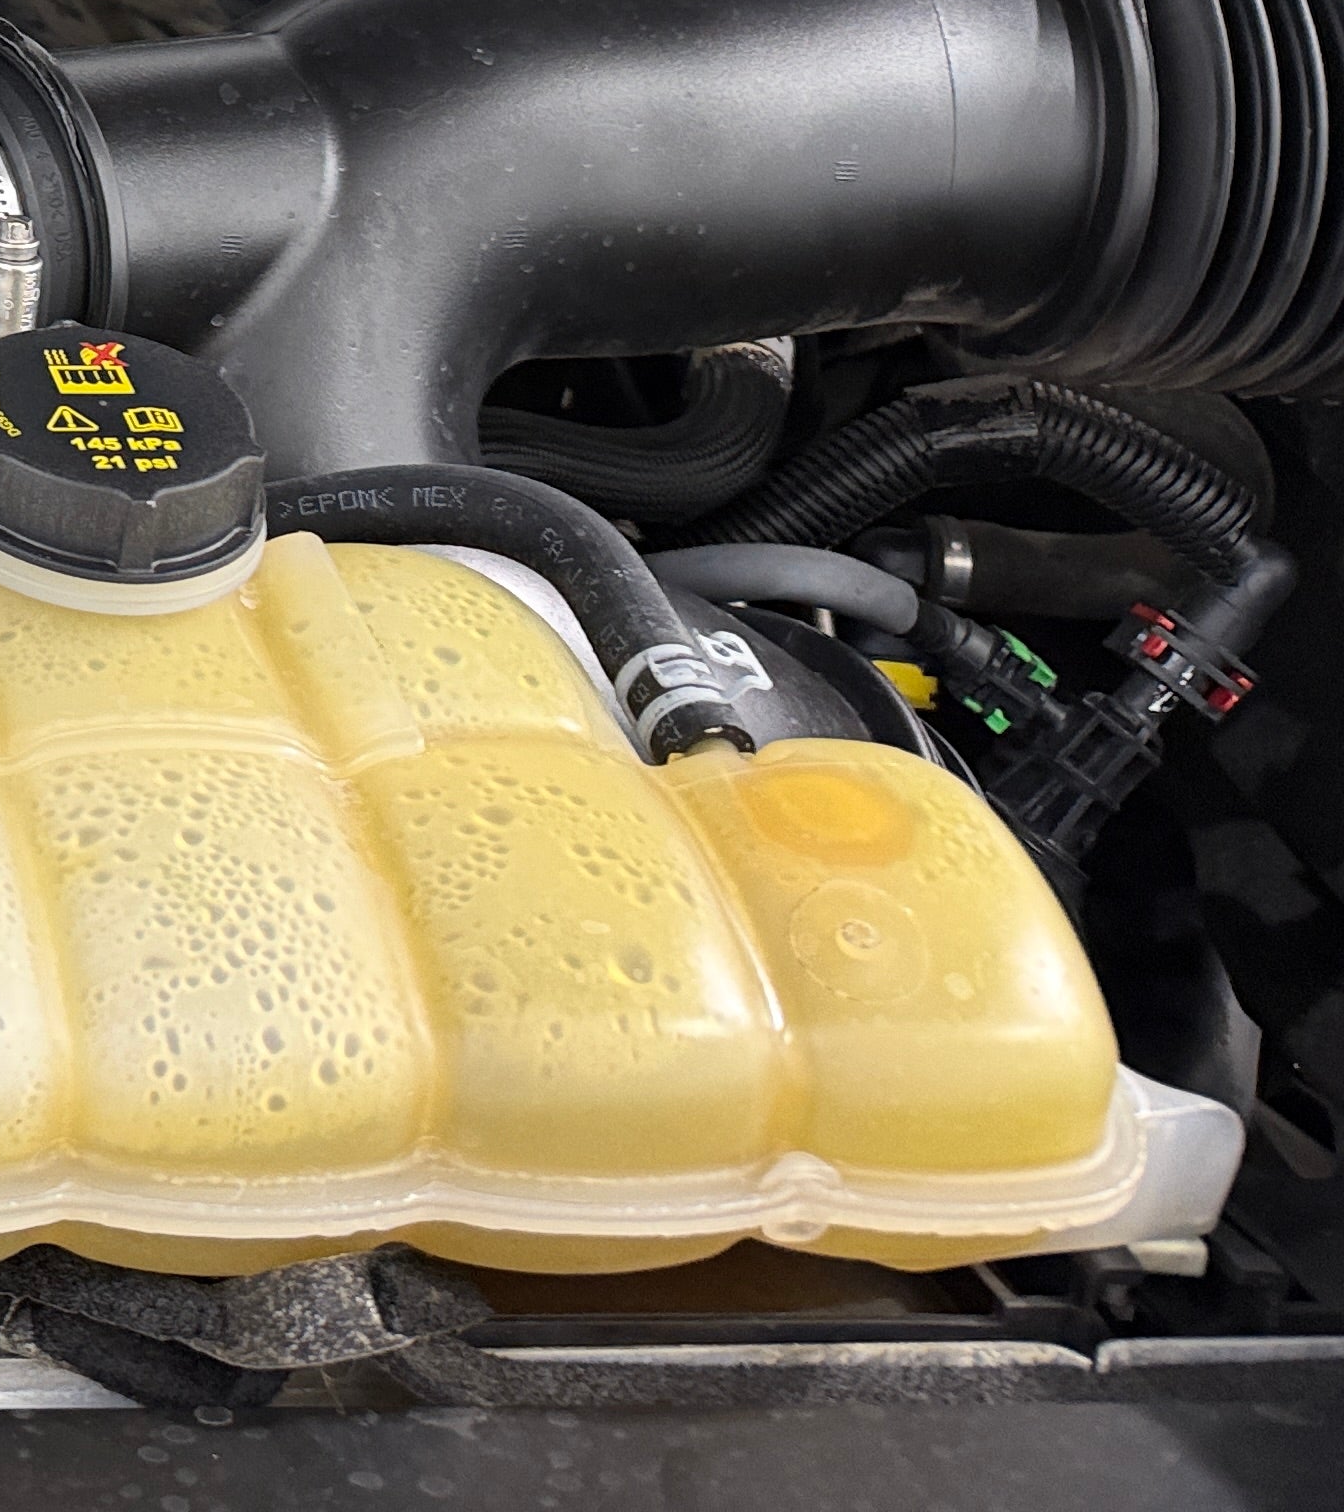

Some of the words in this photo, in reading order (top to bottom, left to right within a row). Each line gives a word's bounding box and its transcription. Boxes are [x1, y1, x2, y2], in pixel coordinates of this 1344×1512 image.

[70, 437, 122, 451] 145
[126, 437, 182, 451] kPa
[92, 455, 127, 470] 21
[134, 455, 178, 472] psi
[412, 486, 467, 510] MEX
